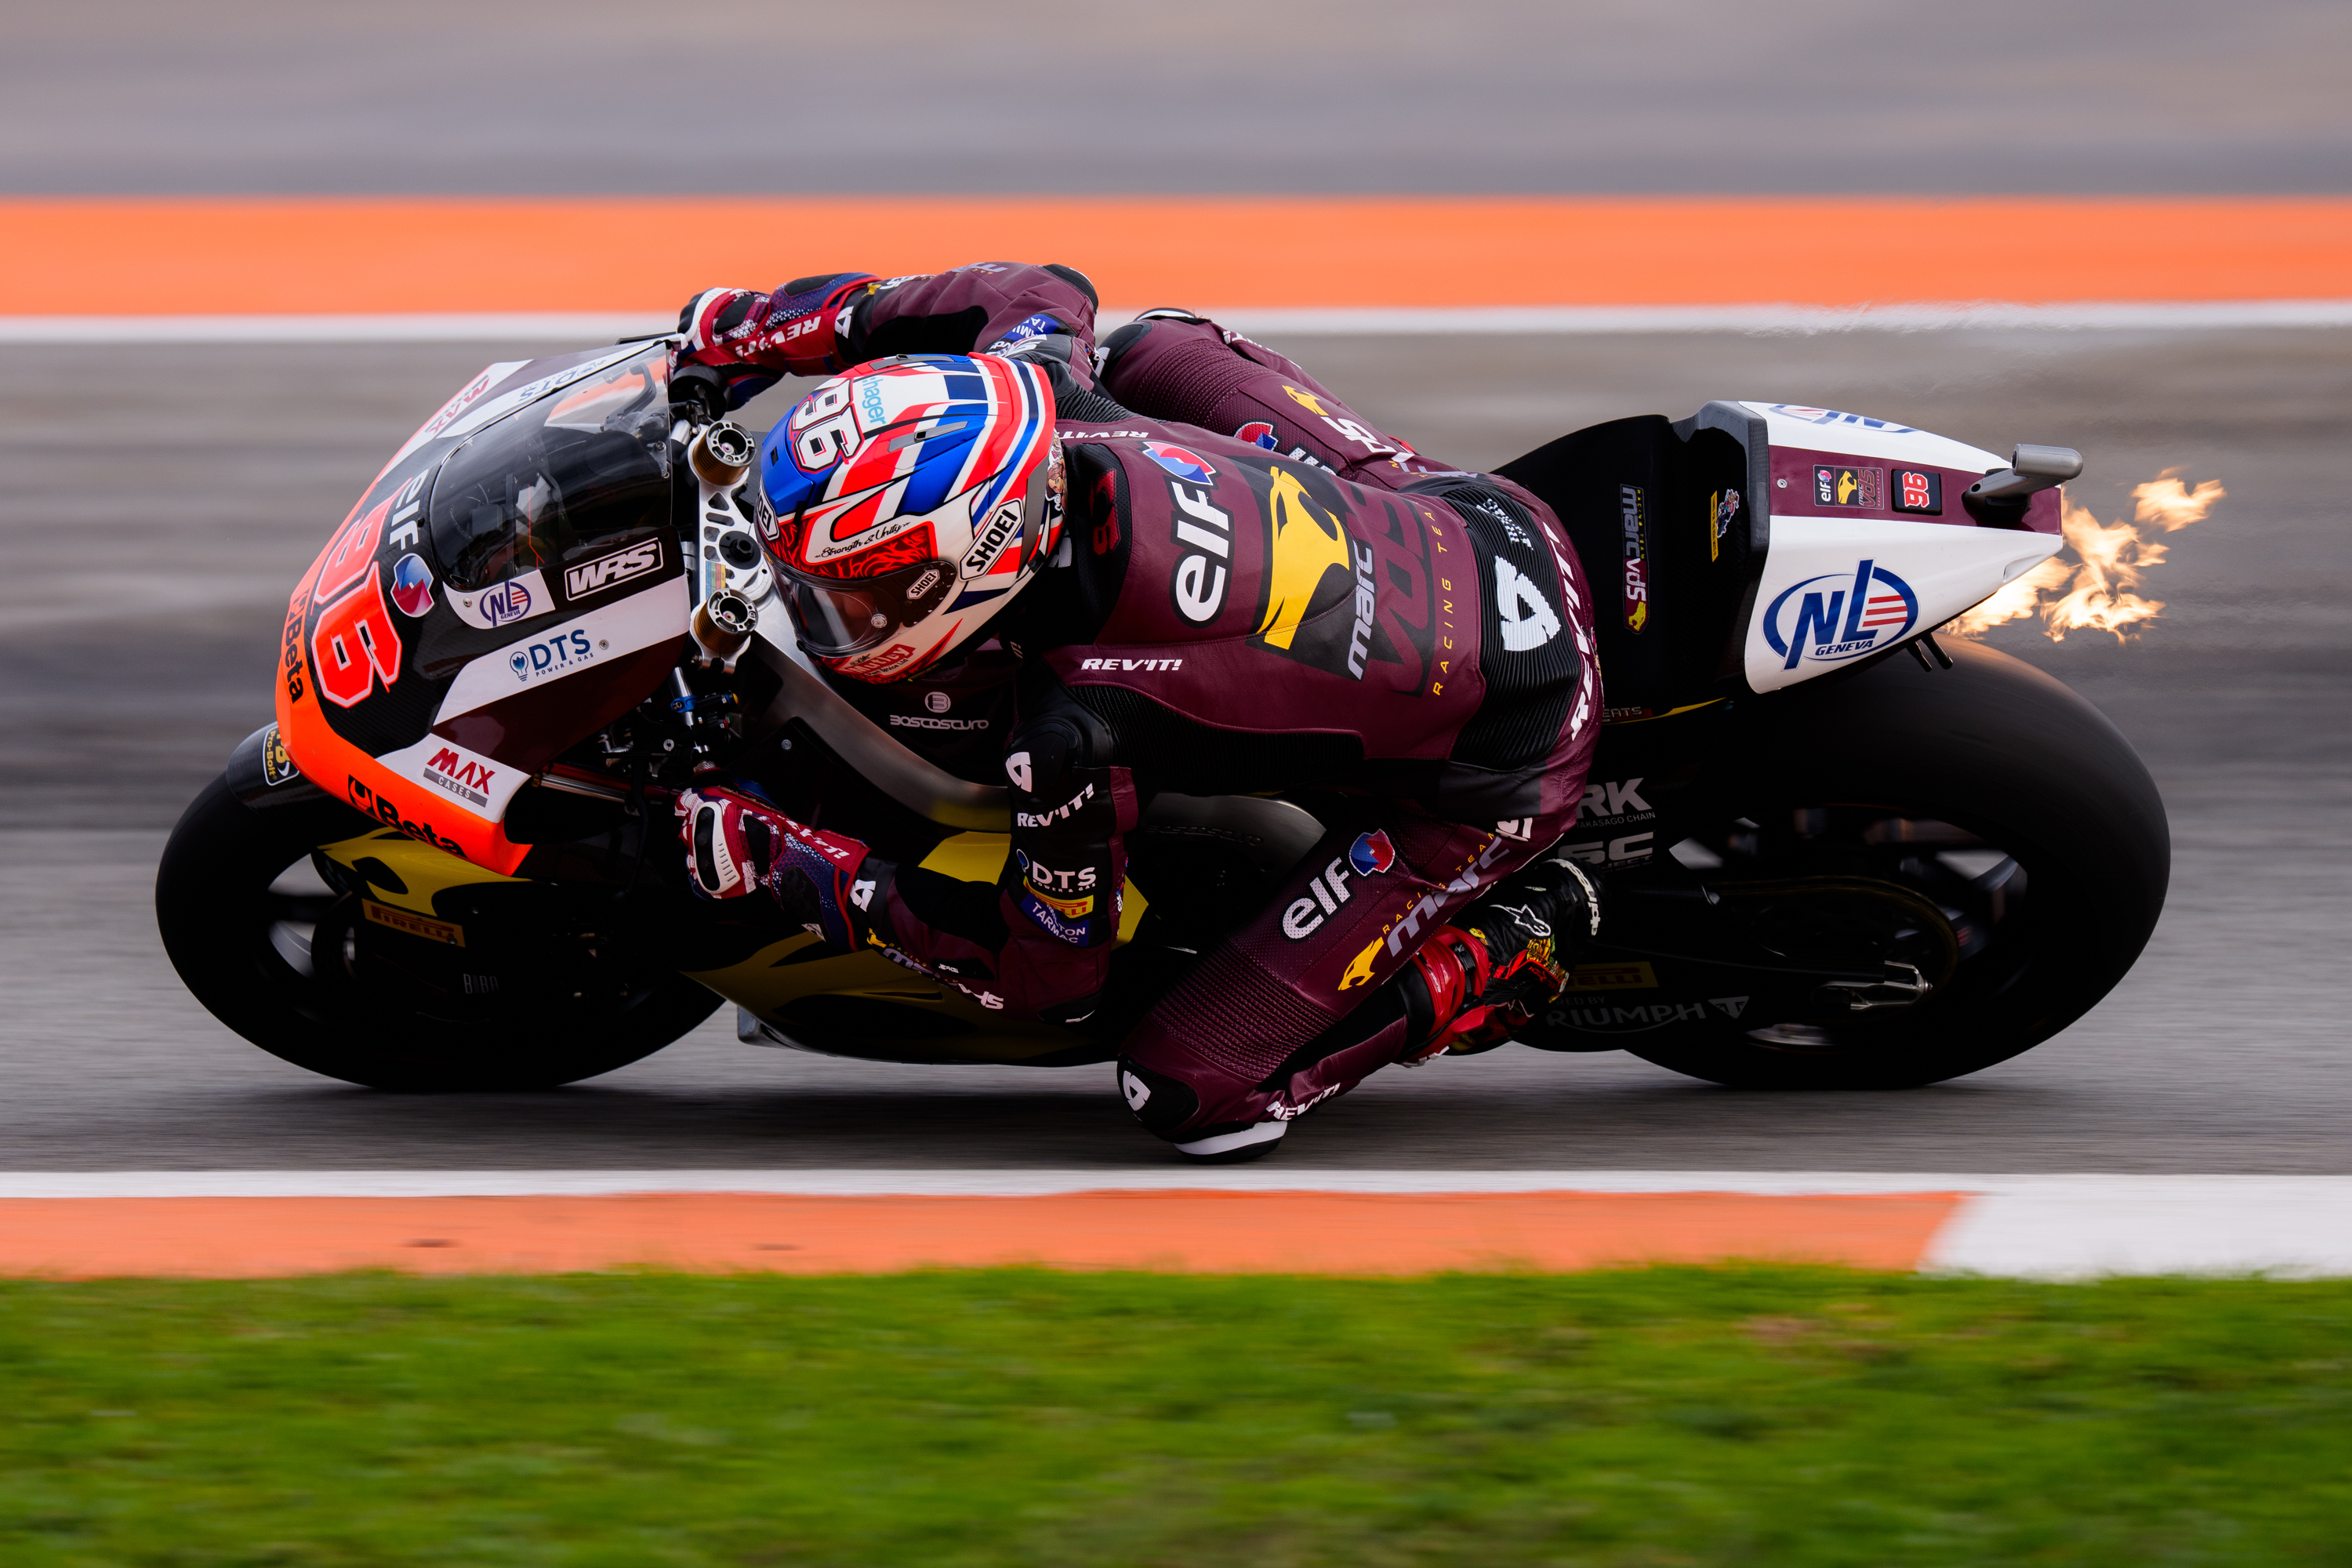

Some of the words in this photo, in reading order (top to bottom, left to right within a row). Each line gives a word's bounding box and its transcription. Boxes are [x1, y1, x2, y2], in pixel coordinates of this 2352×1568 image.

[791, 378, 863, 473] 96
[1058, 430, 1149, 440] REV'IT
[1820, 481, 1831, 503] elf
[1901, 471, 1930, 508] 96
[390, 469, 429, 550] elf
[757, 497, 772, 532] OEI
[1414, 500, 1448, 554] TEA
[821, 539, 863, 558] Strength
[864, 534, 875, 546] &
[876, 523, 902, 540] Unity
[966, 508, 1018, 572] SHOEI
[1175, 481, 1231, 622] elf
[569, 543, 657, 594] WRS
[910, 572, 935, 596] SHOEI
[500, 610, 521, 620] GENEVA
[528, 629, 591, 671] DTS
[1433, 578, 1454, 696] RACING
[1815, 639, 1874, 657] GENEVA
[285, 620, 304, 704] Beta
[535, 663, 565, 677] POWER
[578, 652, 594, 662] GAS
[1081, 657, 1181, 672] REV'IT!
[1602, 706, 1643, 718] EATS
[426, 746, 496, 795] MAX
[438, 776, 471, 799] CASES
[1018, 782, 1094, 828] REV'IT!
[1577, 777, 1653, 819] RK
[376, 794, 469, 859] Beta
[1576, 816, 1624, 830] TAKASAGO
[1627, 811, 1656, 823] CHAIN
[1033, 860, 1097, 889] DTS
[1601, 855, 1653, 869] JECT
[1033, 878, 1064, 893] POWER
[1078, 883, 1096, 891] GAS
[1282, 855, 1352, 940] elf
[1032, 902, 1079, 944] TARMAC
[1545, 1003, 1707, 1027] RIUMPH
[1588, 996, 1606, 1005] BY
